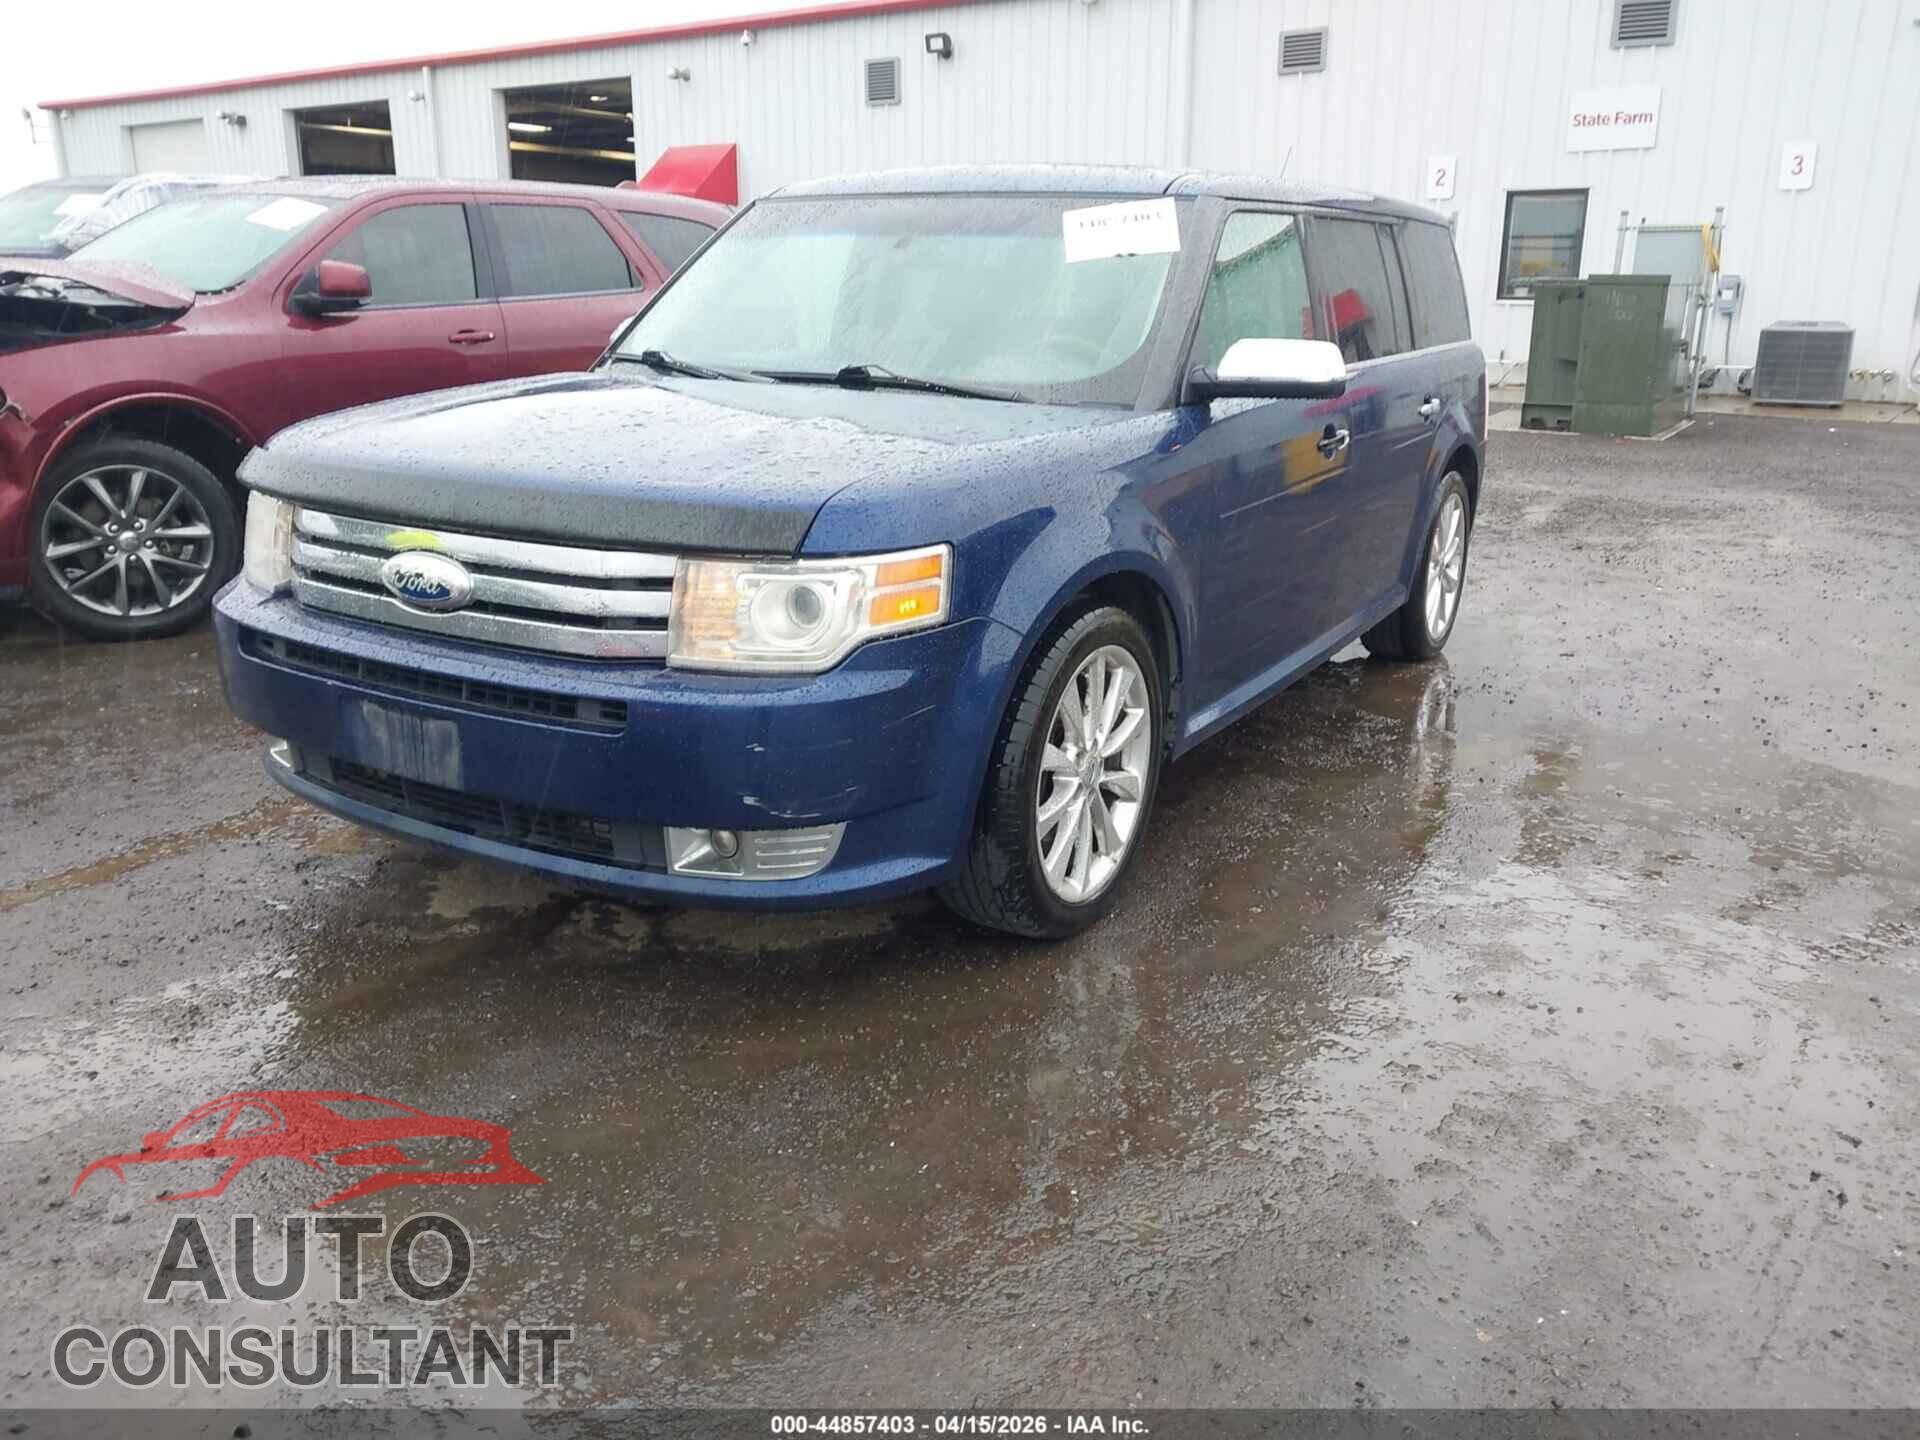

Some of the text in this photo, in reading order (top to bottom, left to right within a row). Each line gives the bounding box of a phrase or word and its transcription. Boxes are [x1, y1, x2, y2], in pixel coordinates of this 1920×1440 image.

[1573, 111, 1654, 127] State Farm
[1791, 155, 1804, 175] 3
[1435, 168, 1446, 187] 2
[393, 569, 444, 595] Ford
